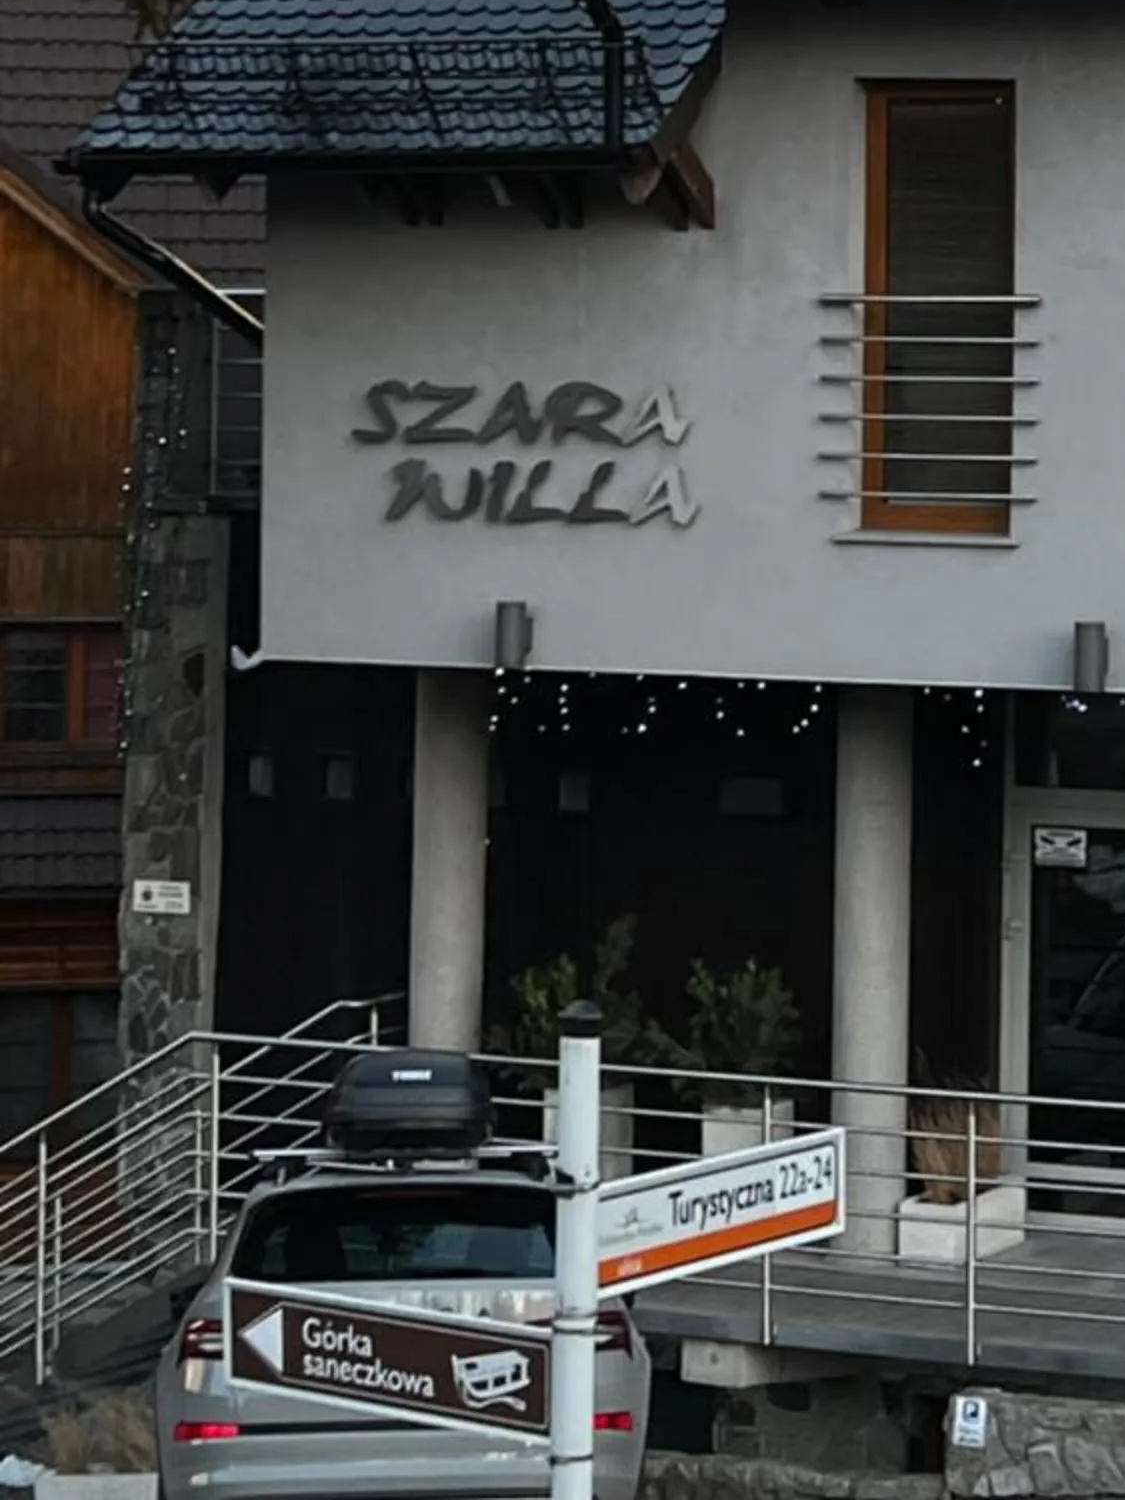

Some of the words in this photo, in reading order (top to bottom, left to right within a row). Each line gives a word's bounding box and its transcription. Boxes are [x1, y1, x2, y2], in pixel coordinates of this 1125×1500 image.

[350, 380, 692, 447] SZARA
[668, 1180, 773, 1231] Turystyczna
[779, 1155, 832, 1199] 22a-24
[302, 1317, 372, 1357] Górka
[303, 1354, 434, 1397] saneczkowa
